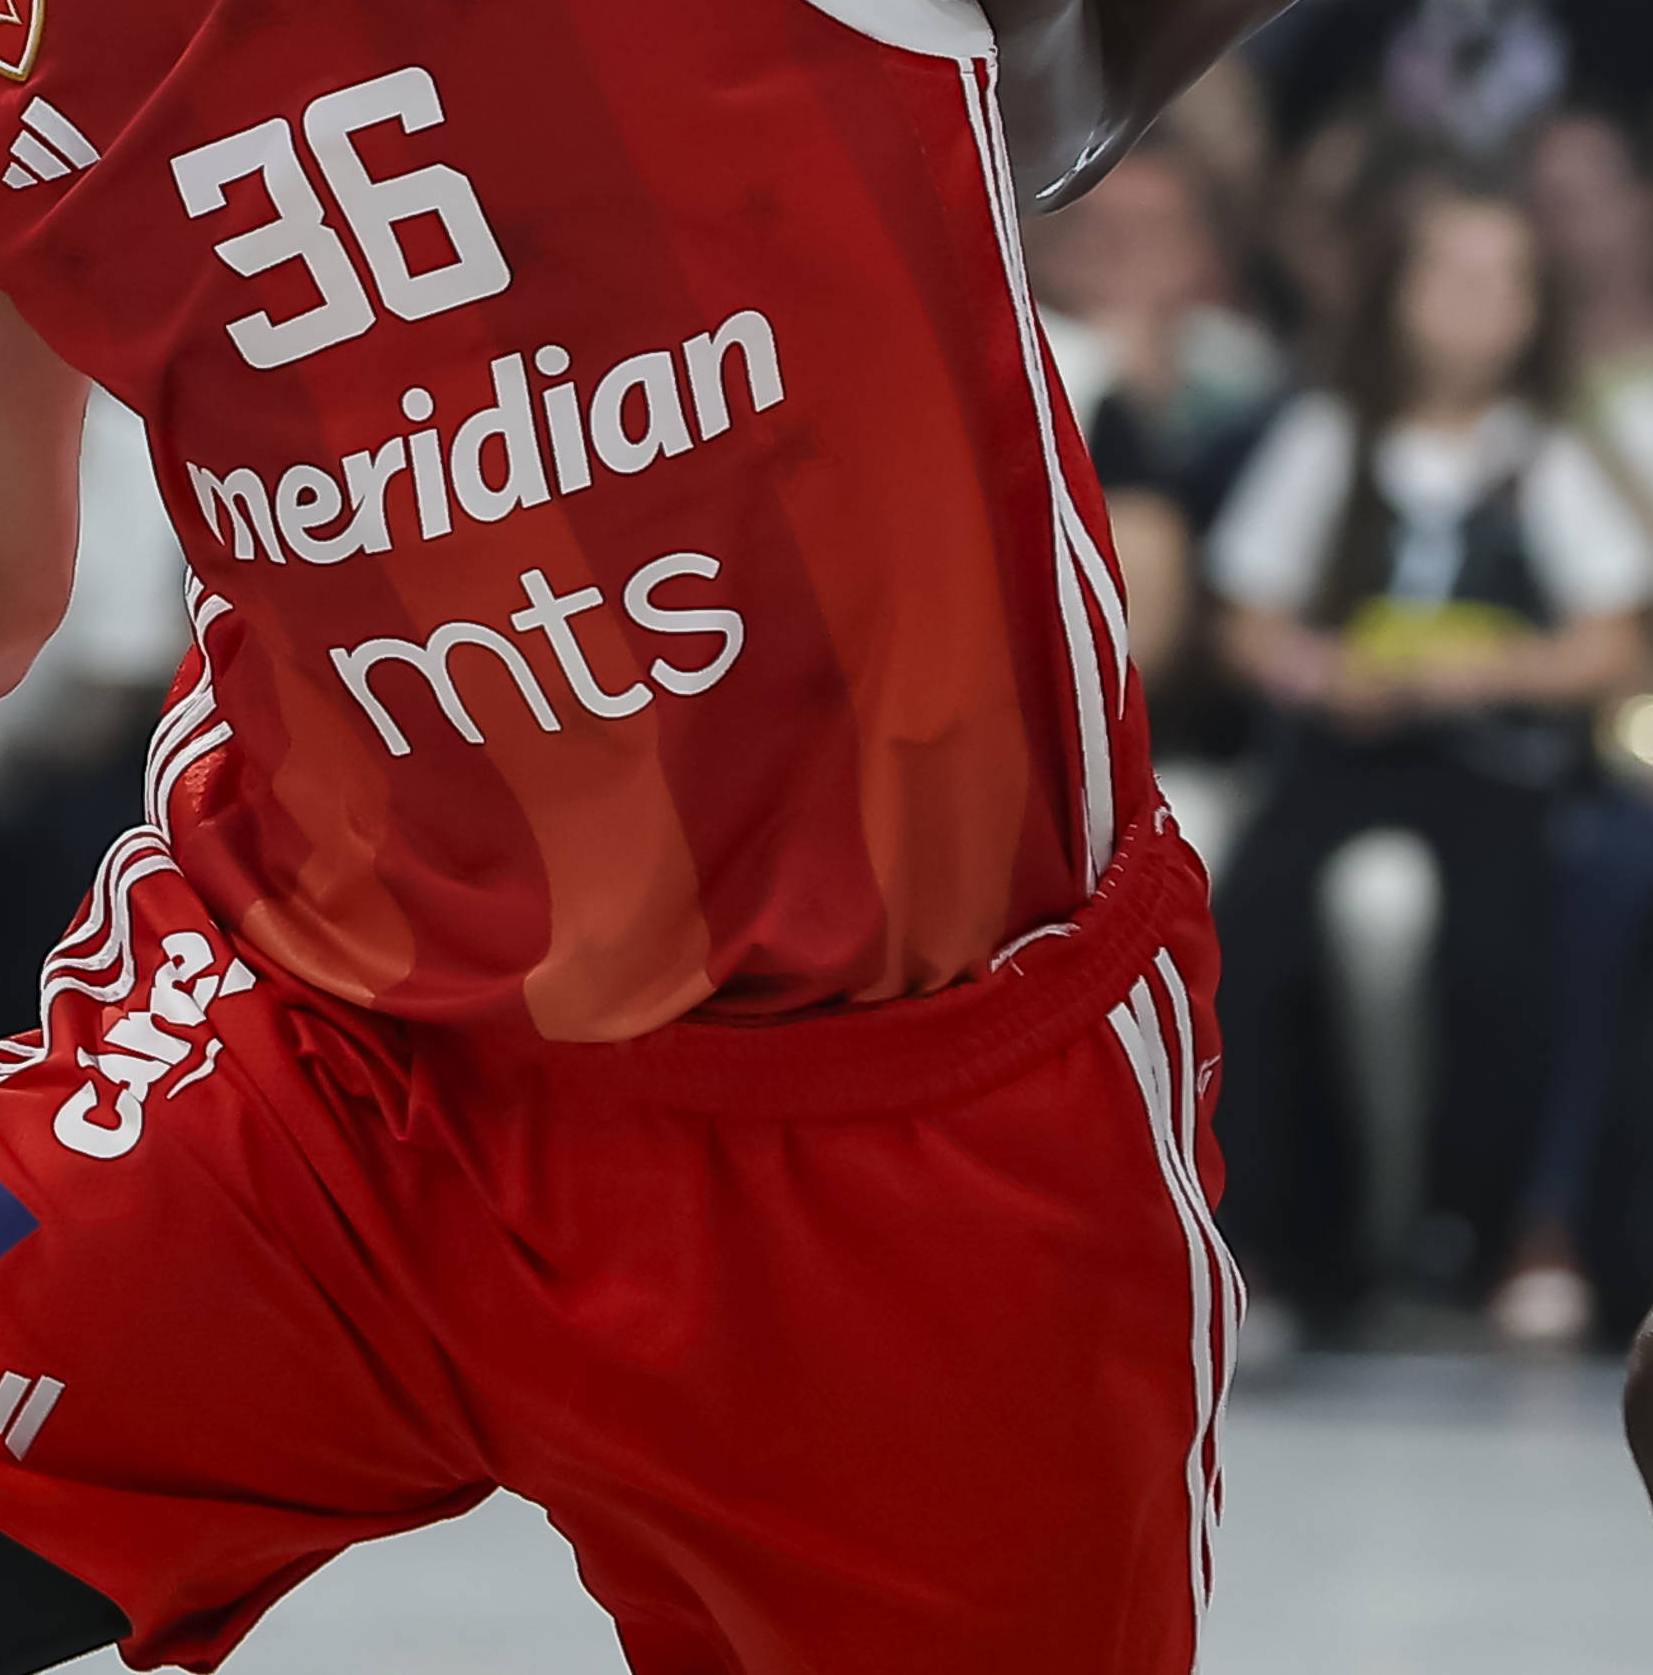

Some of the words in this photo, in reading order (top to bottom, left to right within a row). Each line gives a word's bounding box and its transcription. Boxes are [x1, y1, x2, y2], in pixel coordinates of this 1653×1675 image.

[170, 67, 512, 369] 36
[186, 310, 786, 565] meridian
[329, 552, 745, 757] mts
